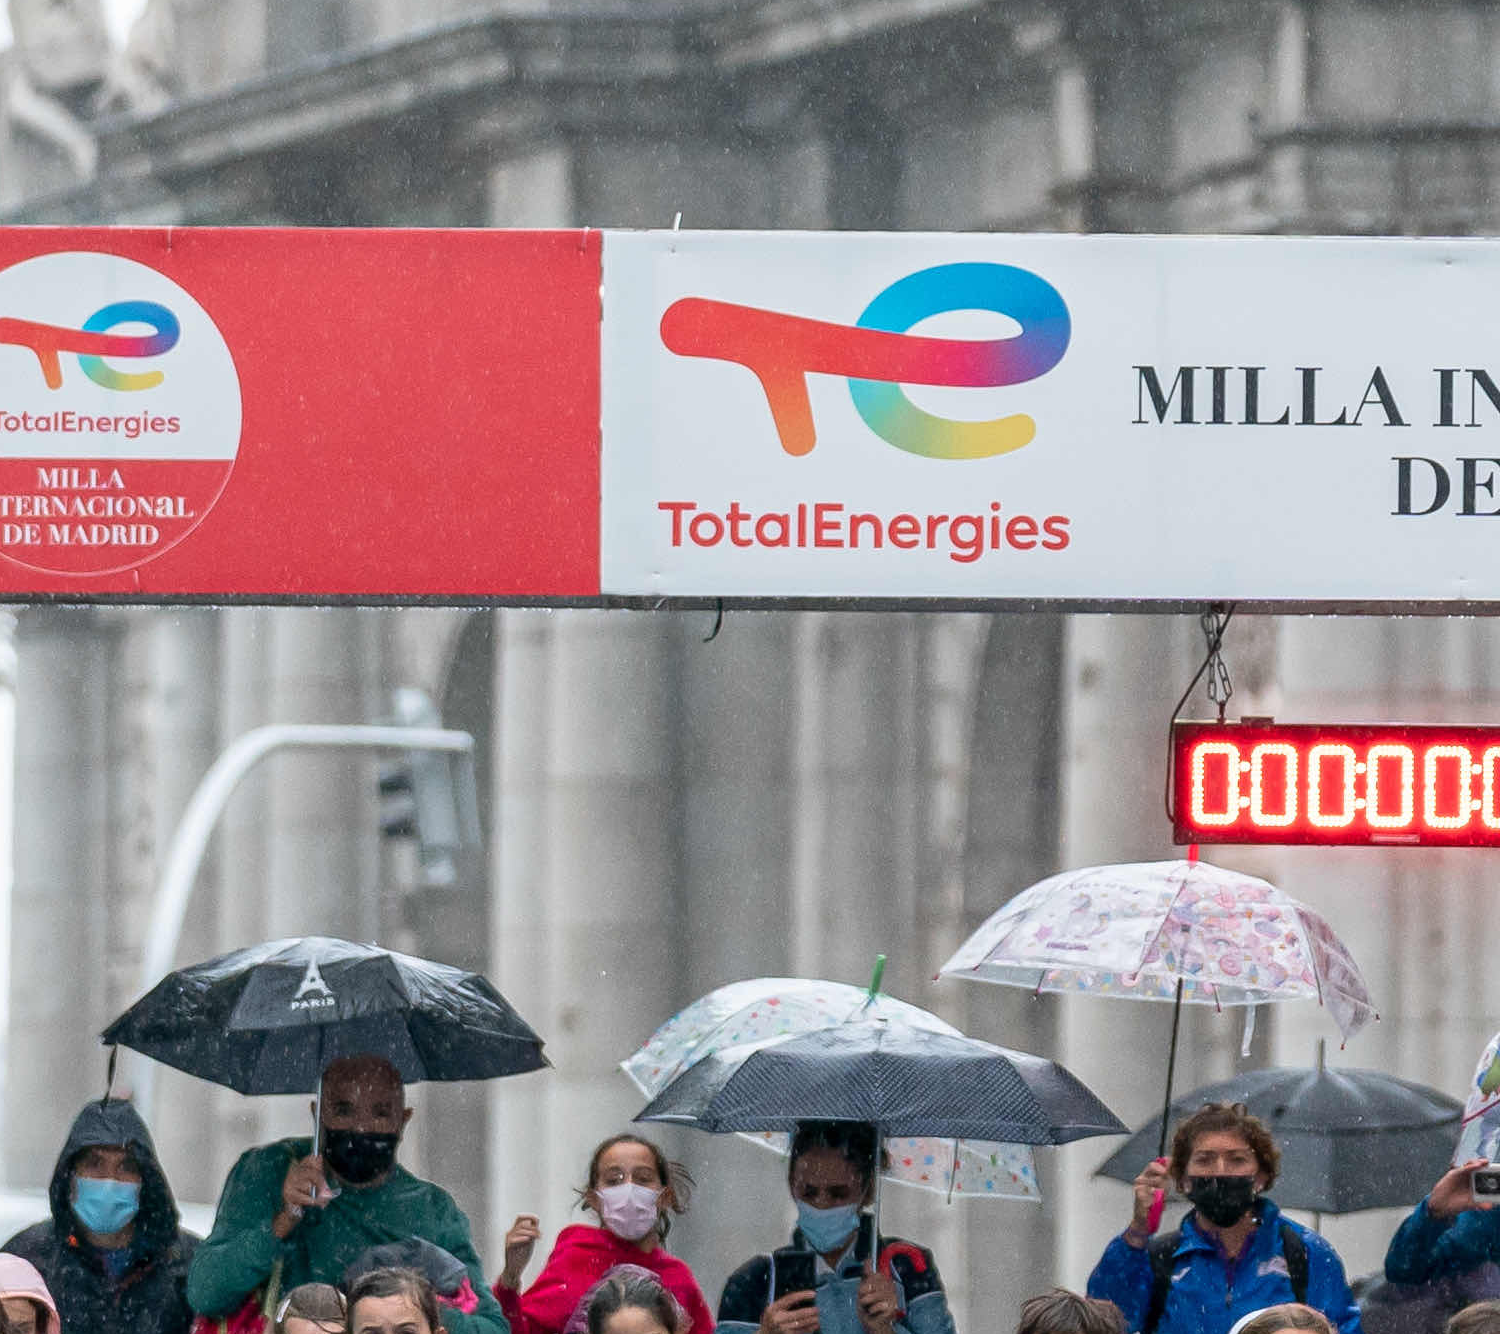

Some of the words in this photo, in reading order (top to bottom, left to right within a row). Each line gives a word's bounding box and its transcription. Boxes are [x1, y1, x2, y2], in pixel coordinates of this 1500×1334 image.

[1131, 365, 1411, 427] MILLA
[38, 468, 125, 489] MILLA
[3, 523, 41, 545] DE
[48, 524, 160, 546] MADRID
[656, 501, 1071, 564] TotalEnergies
[291, 996, 336, 1010] PARIS
